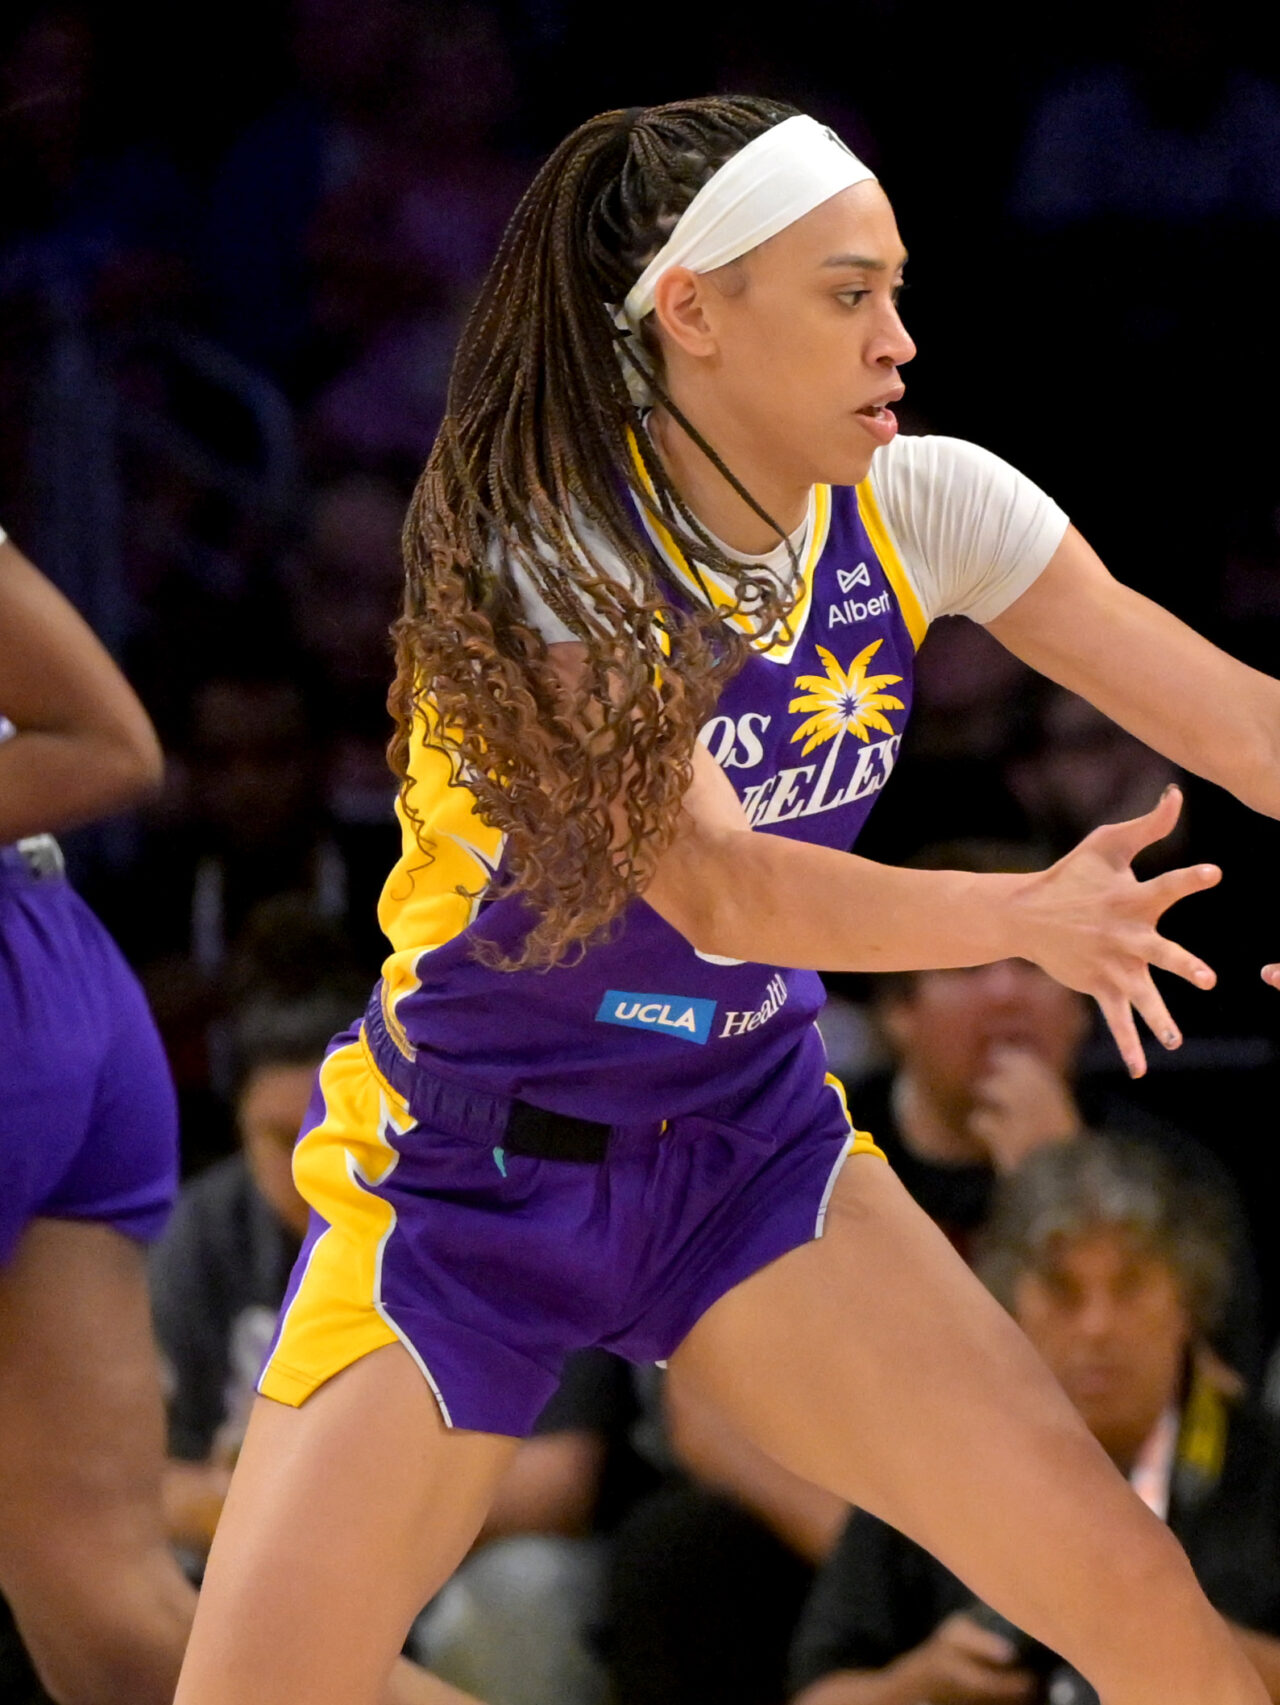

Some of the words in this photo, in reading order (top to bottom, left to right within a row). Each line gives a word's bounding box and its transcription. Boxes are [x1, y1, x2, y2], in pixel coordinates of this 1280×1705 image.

[828, 590, 891, 629] Albert
[697, 712, 772, 769] OS
[742, 733, 902, 828] GELES
[614, 1001, 697, 1033] UCLA
